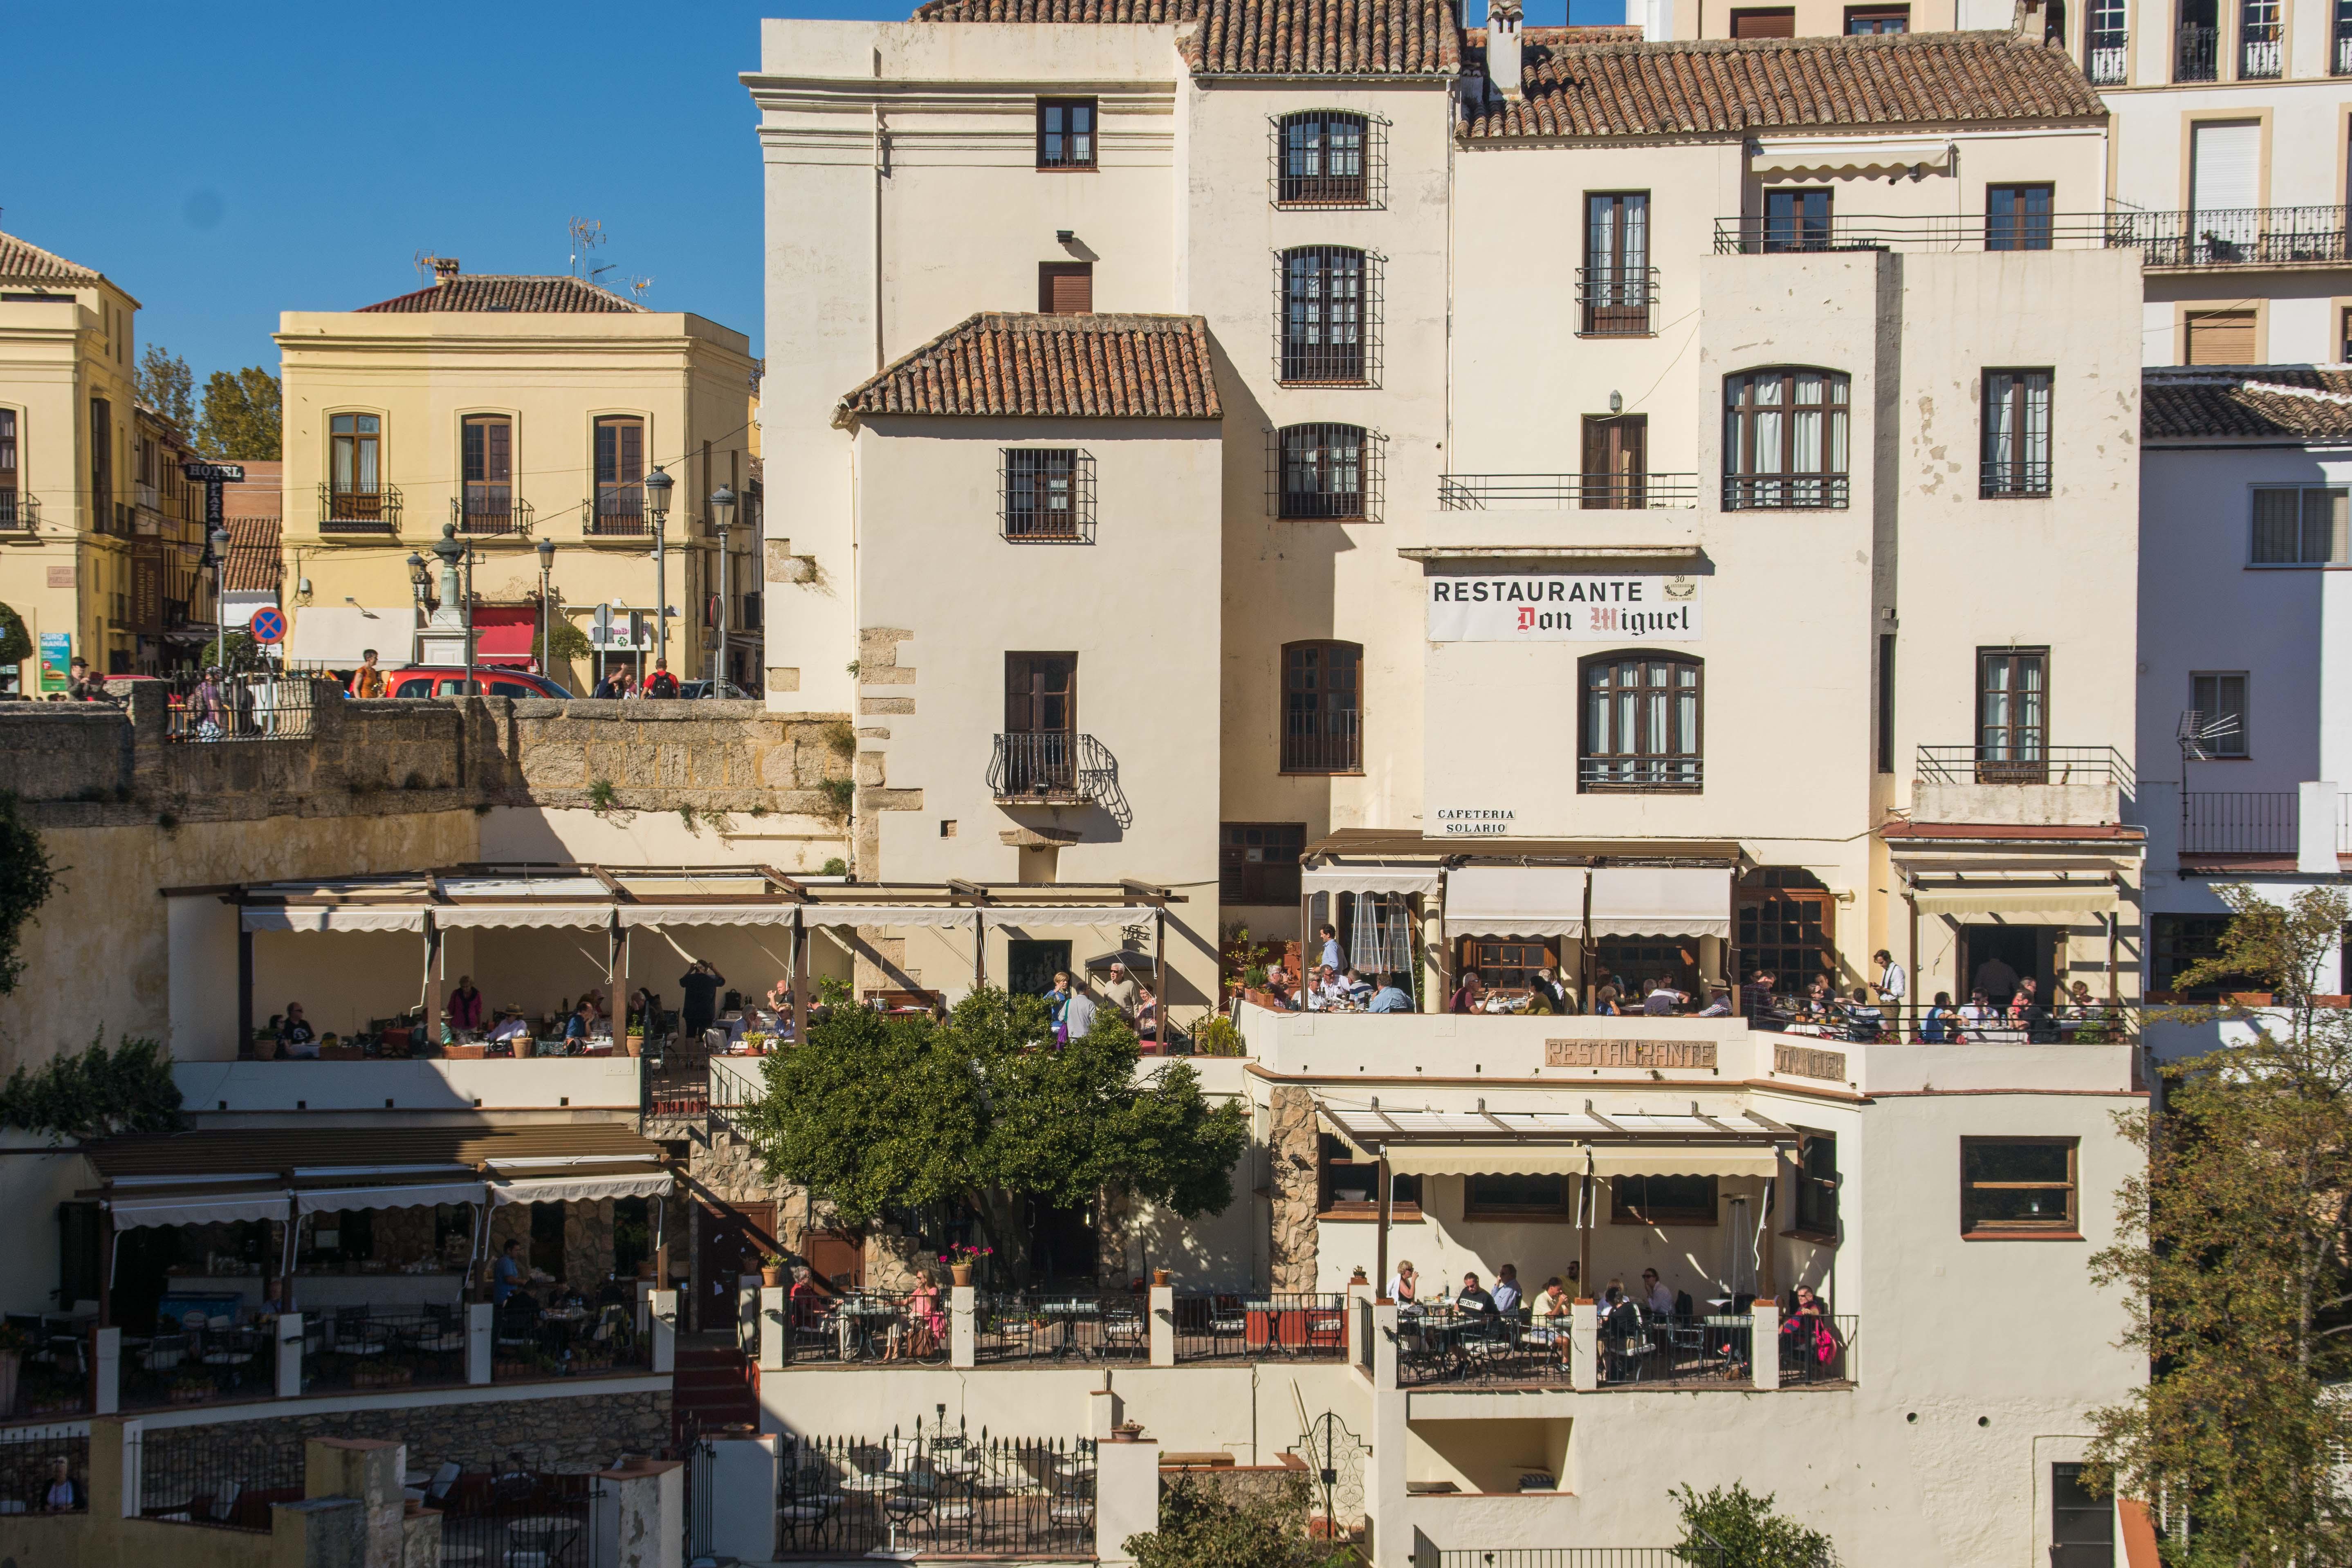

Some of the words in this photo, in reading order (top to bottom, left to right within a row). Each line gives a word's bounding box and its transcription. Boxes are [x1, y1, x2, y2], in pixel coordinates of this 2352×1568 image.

[189, 465, 241, 478] HOTEL
[209, 482, 220, 518] PLAZA
[1434, 581, 1642, 602] RESTAURANTE
[1517, 606, 1573, 634] Don
[1590, 605, 1690, 637] Miguel
[1438, 810, 1514, 818] CAFETERIA
[1446, 824, 1505, 832] SOLARIO
[1547, 1041, 1715, 1066] RESTAURANTE
[1775, 1048, 1798, 1074] DON
[1798, 1050, 1843, 1080] MIGUEL
